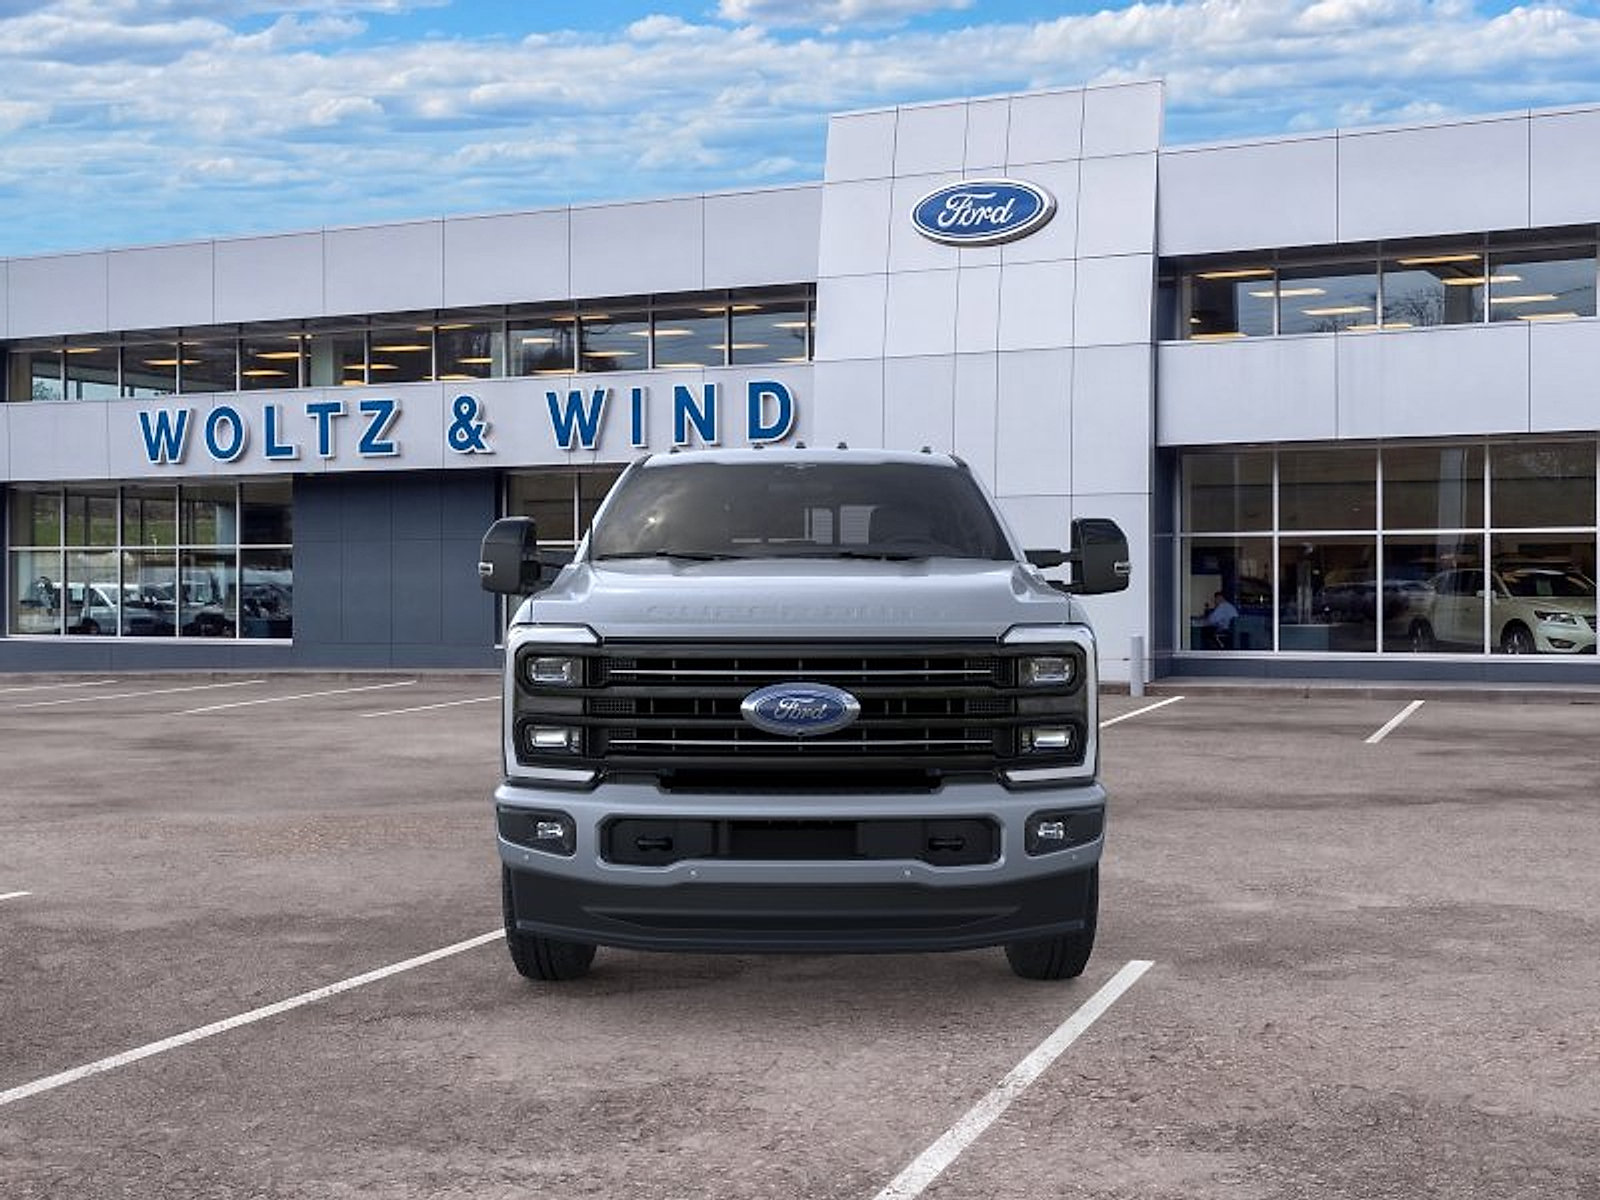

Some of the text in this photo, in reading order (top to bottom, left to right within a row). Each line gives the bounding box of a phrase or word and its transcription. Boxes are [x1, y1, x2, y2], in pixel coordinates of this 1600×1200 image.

[937, 191, 1015, 228] Ford
[138, 380, 796, 463] WOLTZ & WIND
[774, 698, 827, 719] Ford
